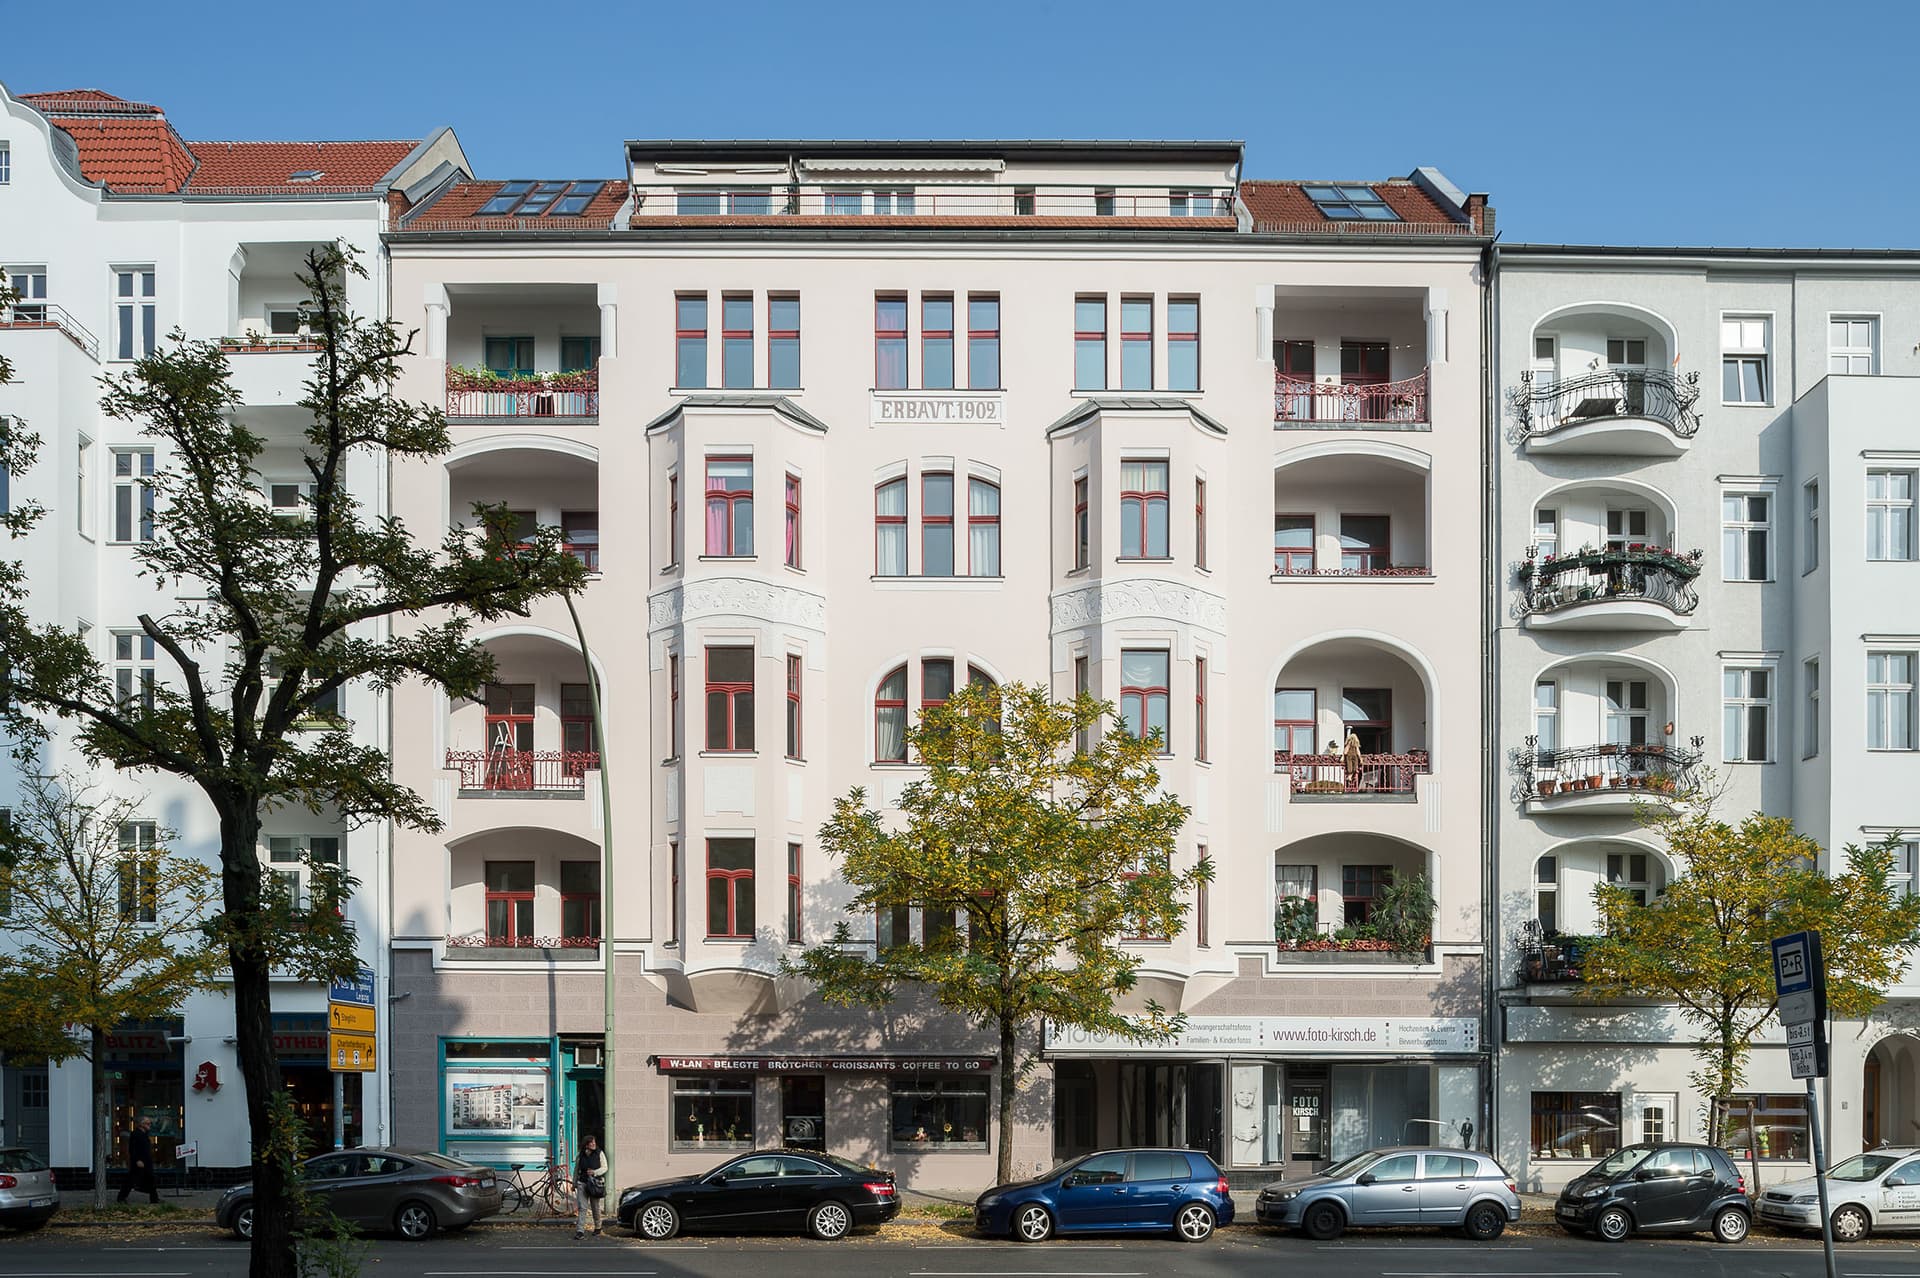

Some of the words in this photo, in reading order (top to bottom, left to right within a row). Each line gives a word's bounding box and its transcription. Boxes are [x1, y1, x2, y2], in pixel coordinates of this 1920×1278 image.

[1430, 1024, 1435, 1033] &
[1186, 1035, 1213, 1044] Familien-
[1213, 1035, 1218, 1044] &
[1219, 1035, 1251, 1044] Kinderfotos
[1273, 1027, 1377, 1042] www.foto-kirsch.de
[1399, 1037, 1447, 1048] Bewerbungsfotos
[670, 1059, 702, 1069] W-LAN
[714, 1060, 759, 1070] BELEGTE
[832, 1061, 896, 1070] CROISSANTS
[902, 1061, 941, 1070] COFFEE
[946, 1061, 960, 1070] TO
[964, 1061, 980, 1070] GO
[1292, 1096, 1319, 1107] FOTO
[1292, 1107, 1319, 1116] KIRSCH
